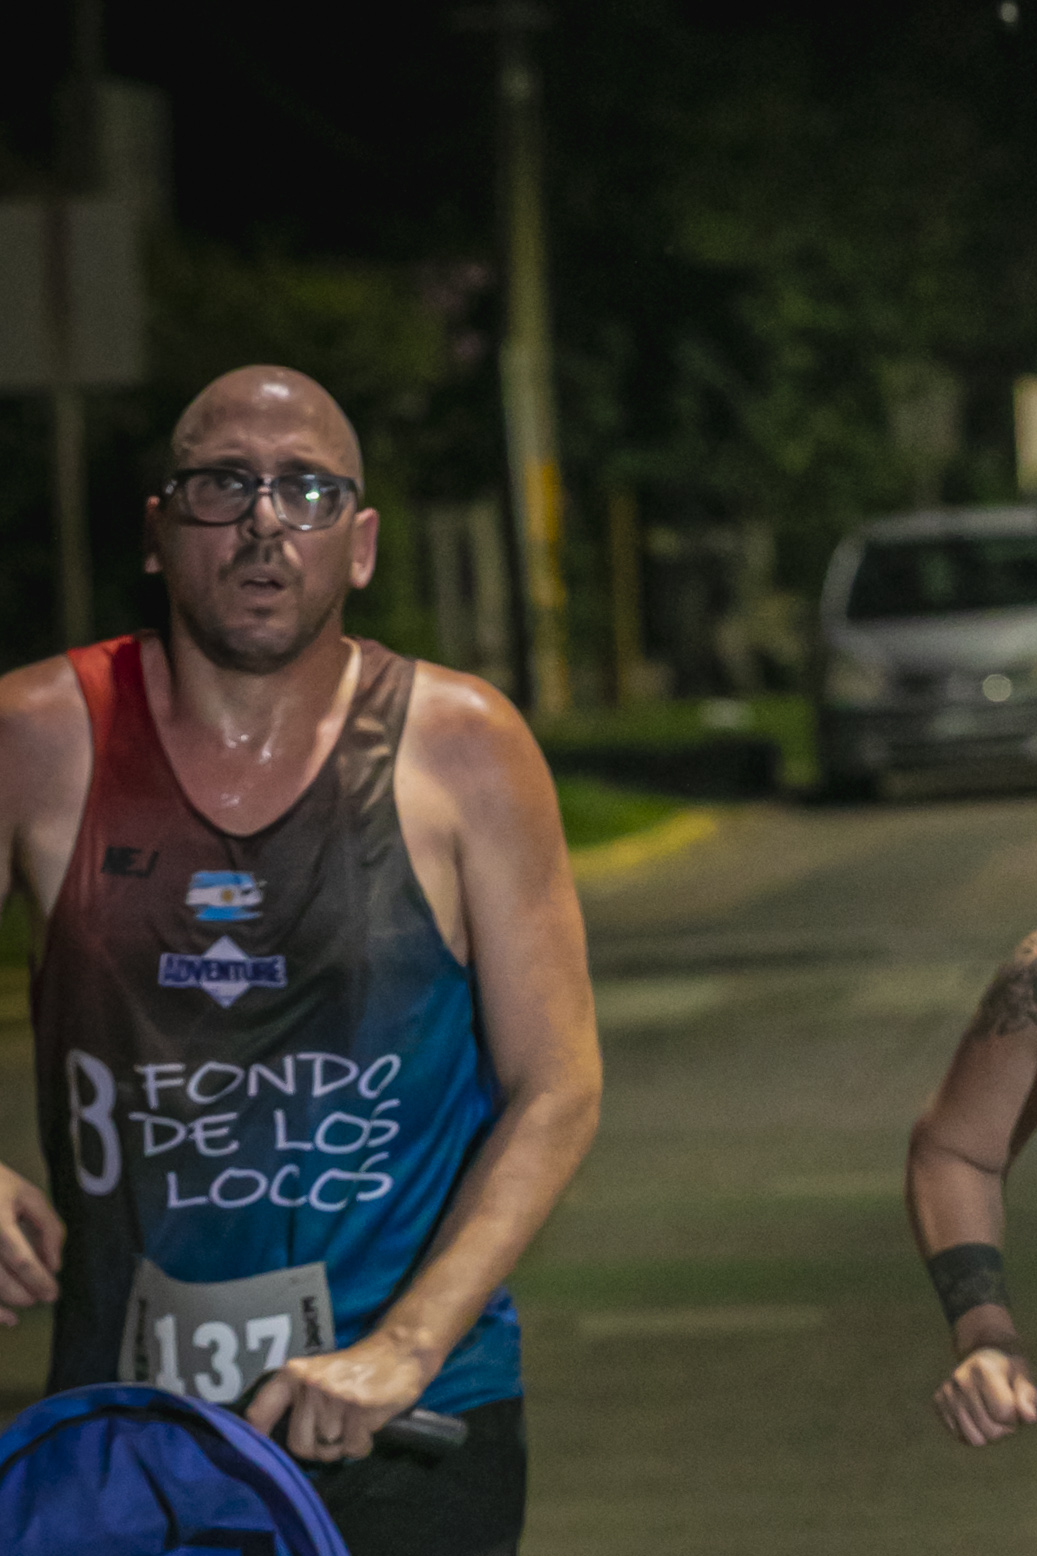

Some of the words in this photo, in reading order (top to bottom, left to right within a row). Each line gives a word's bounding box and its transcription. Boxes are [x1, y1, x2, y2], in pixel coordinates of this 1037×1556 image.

[163, 956, 281, 982] ADVENTURE
[134, 1053, 401, 1110] FONDO
[128, 1111, 240, 1158] DE
[274, 1098, 400, 1155] LOS
[166, 1151, 394, 1213] LOCOS
[155, 1313, 292, 1404] 137
